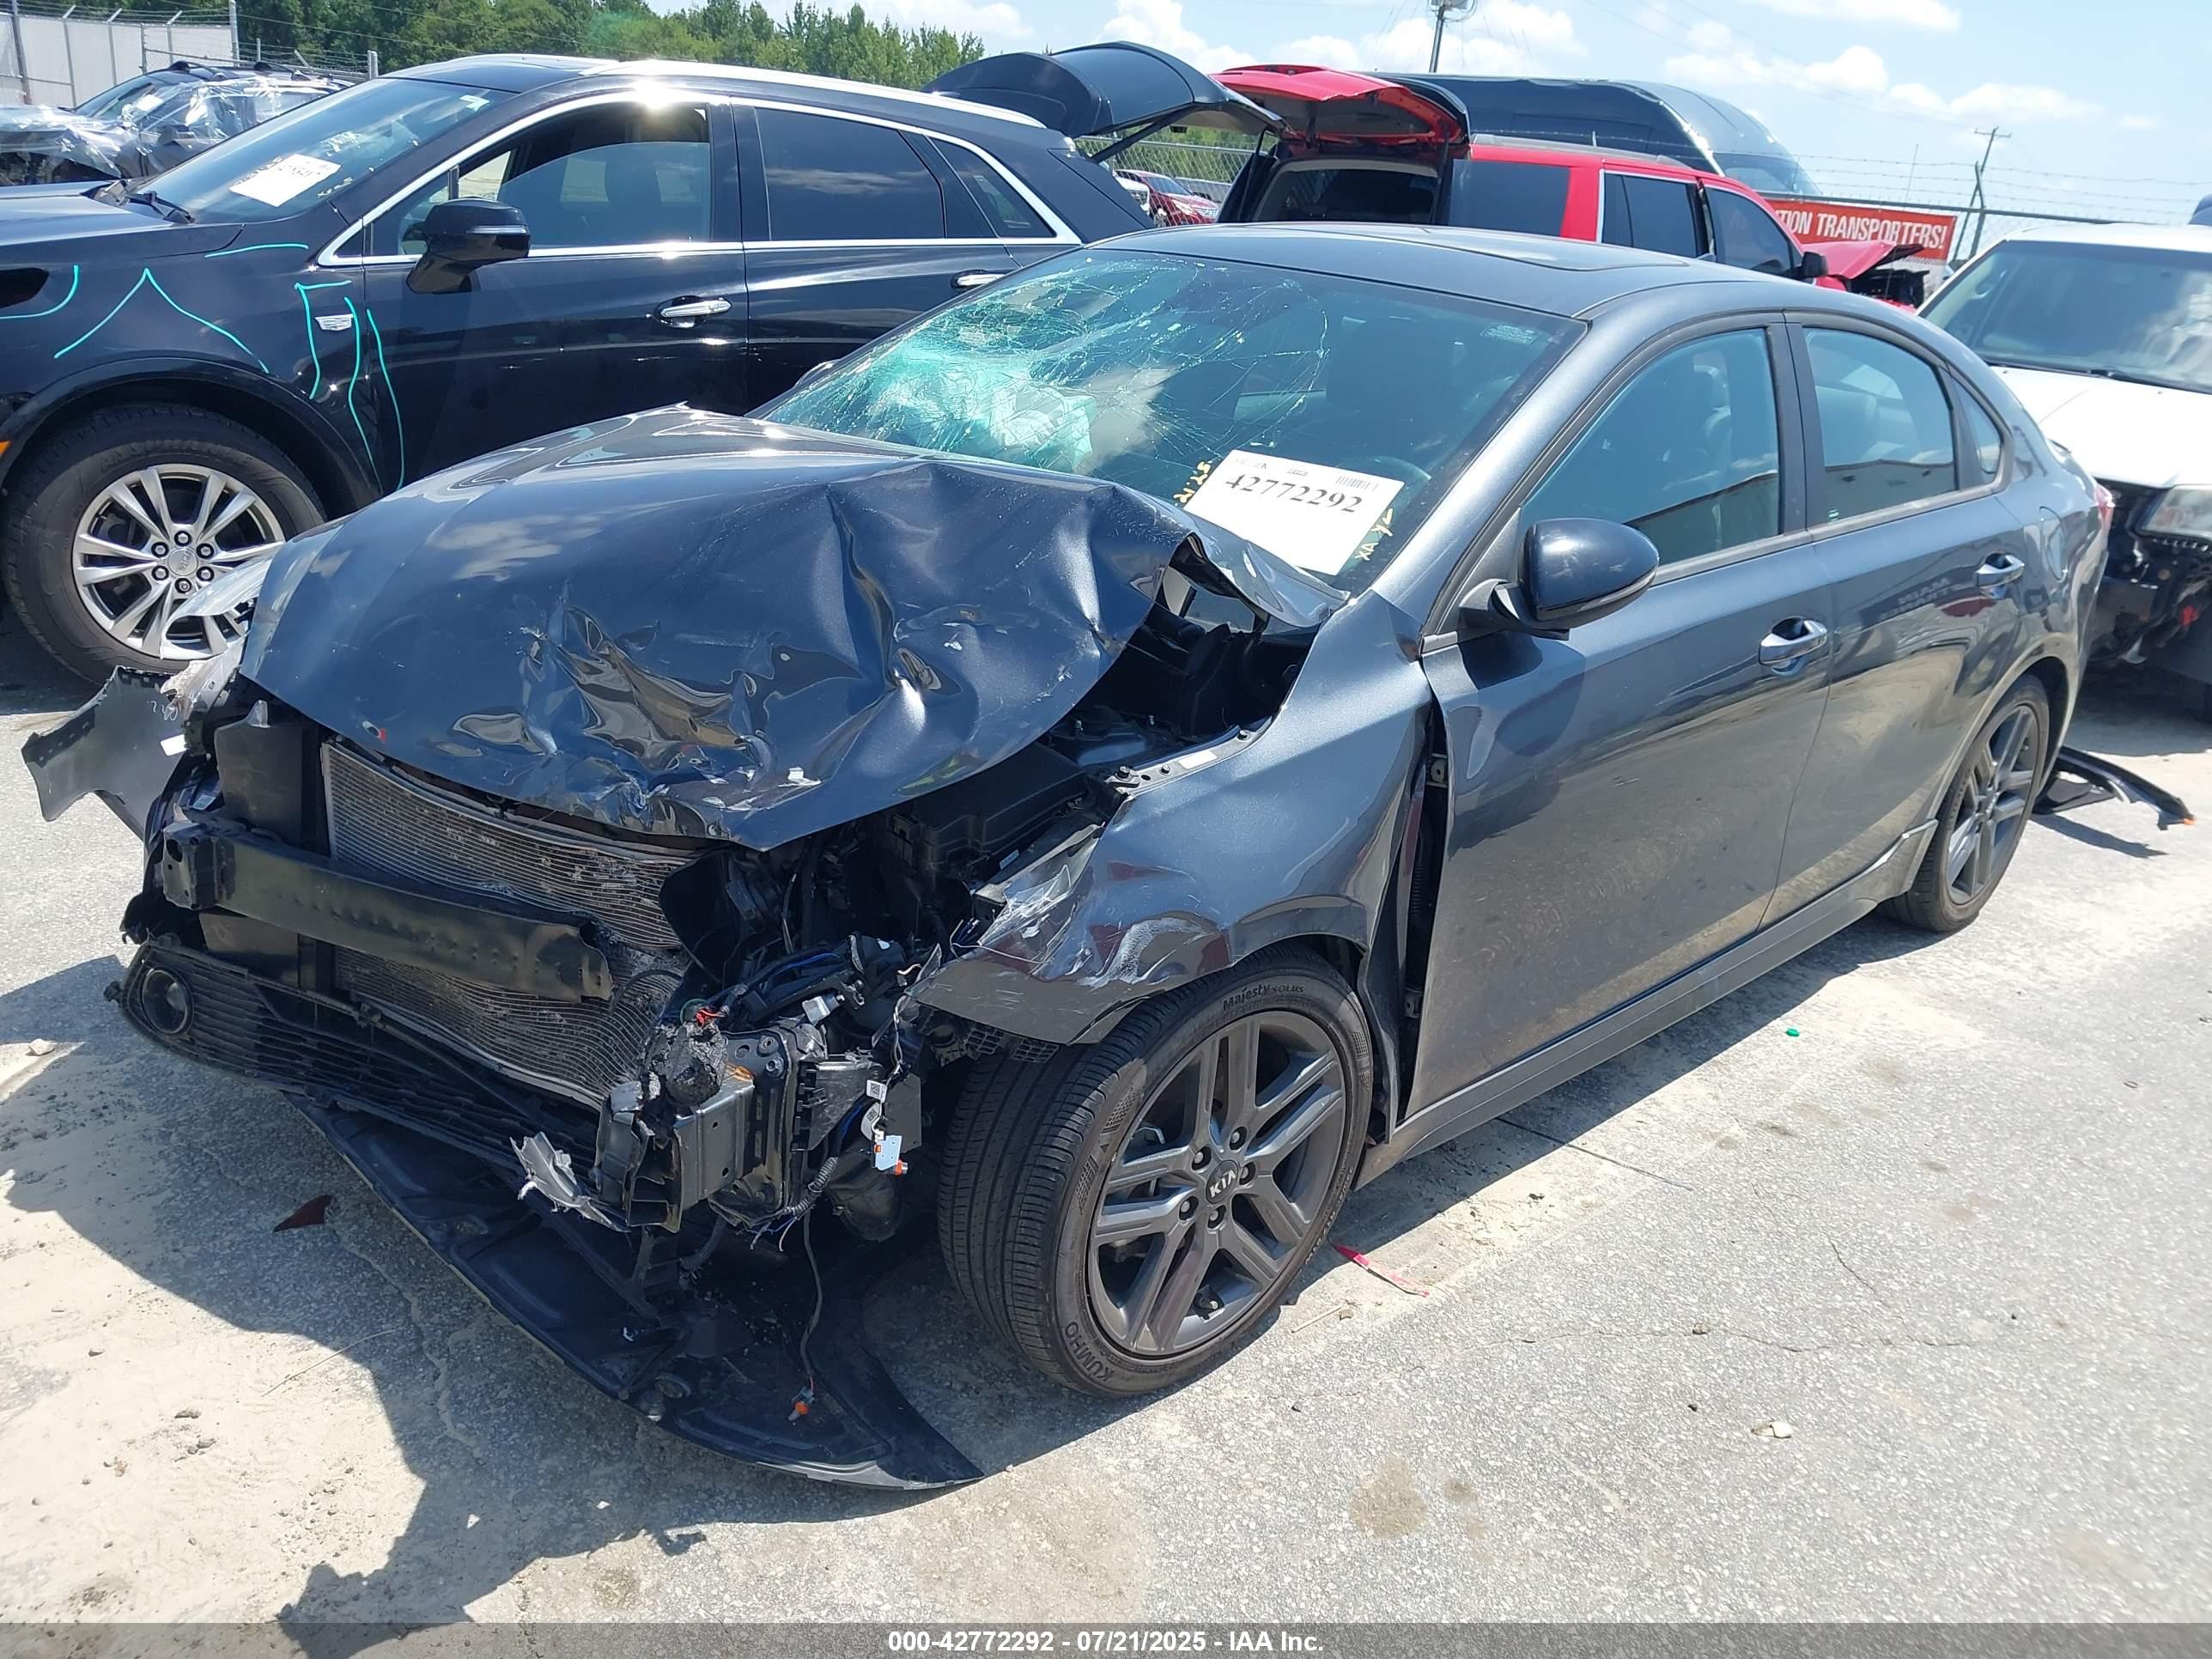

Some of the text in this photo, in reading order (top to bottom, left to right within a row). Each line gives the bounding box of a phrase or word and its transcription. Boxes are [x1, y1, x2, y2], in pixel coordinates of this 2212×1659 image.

[1776, 210, 1948, 250] TION TRANSPORTERS!
[1224, 473, 1364, 514] 42772292
[1209, 1169, 1237, 1199] KIA
[1064, 1320, 1115, 1382] KUMHO
